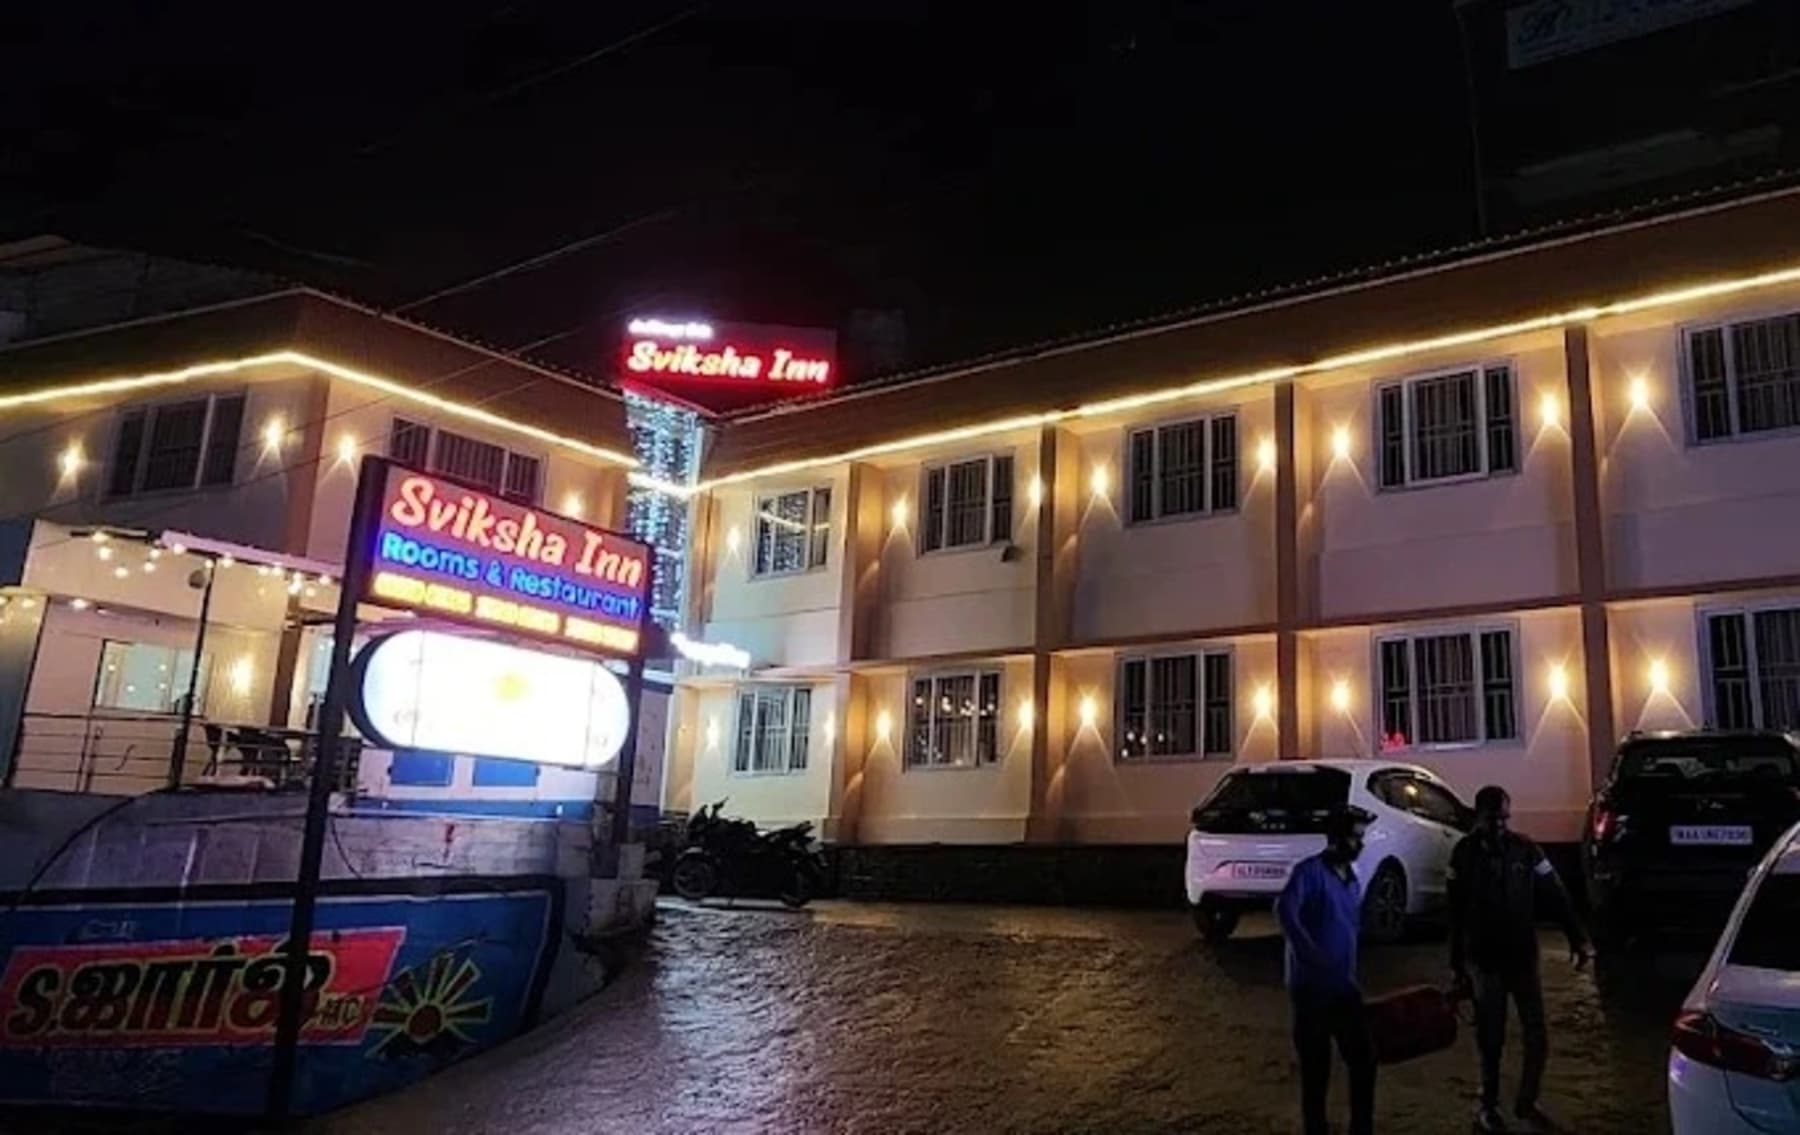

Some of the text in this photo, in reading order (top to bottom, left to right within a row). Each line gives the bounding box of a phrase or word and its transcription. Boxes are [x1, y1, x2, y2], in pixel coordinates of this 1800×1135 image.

[629, 343, 829, 382] Sviksha Inn
[391, 476, 642, 588] Sviksha Inn
[382, 534, 478, 578] Rooms
[487, 561, 504, 587] &
[511, 568, 641, 620] Restaurant
